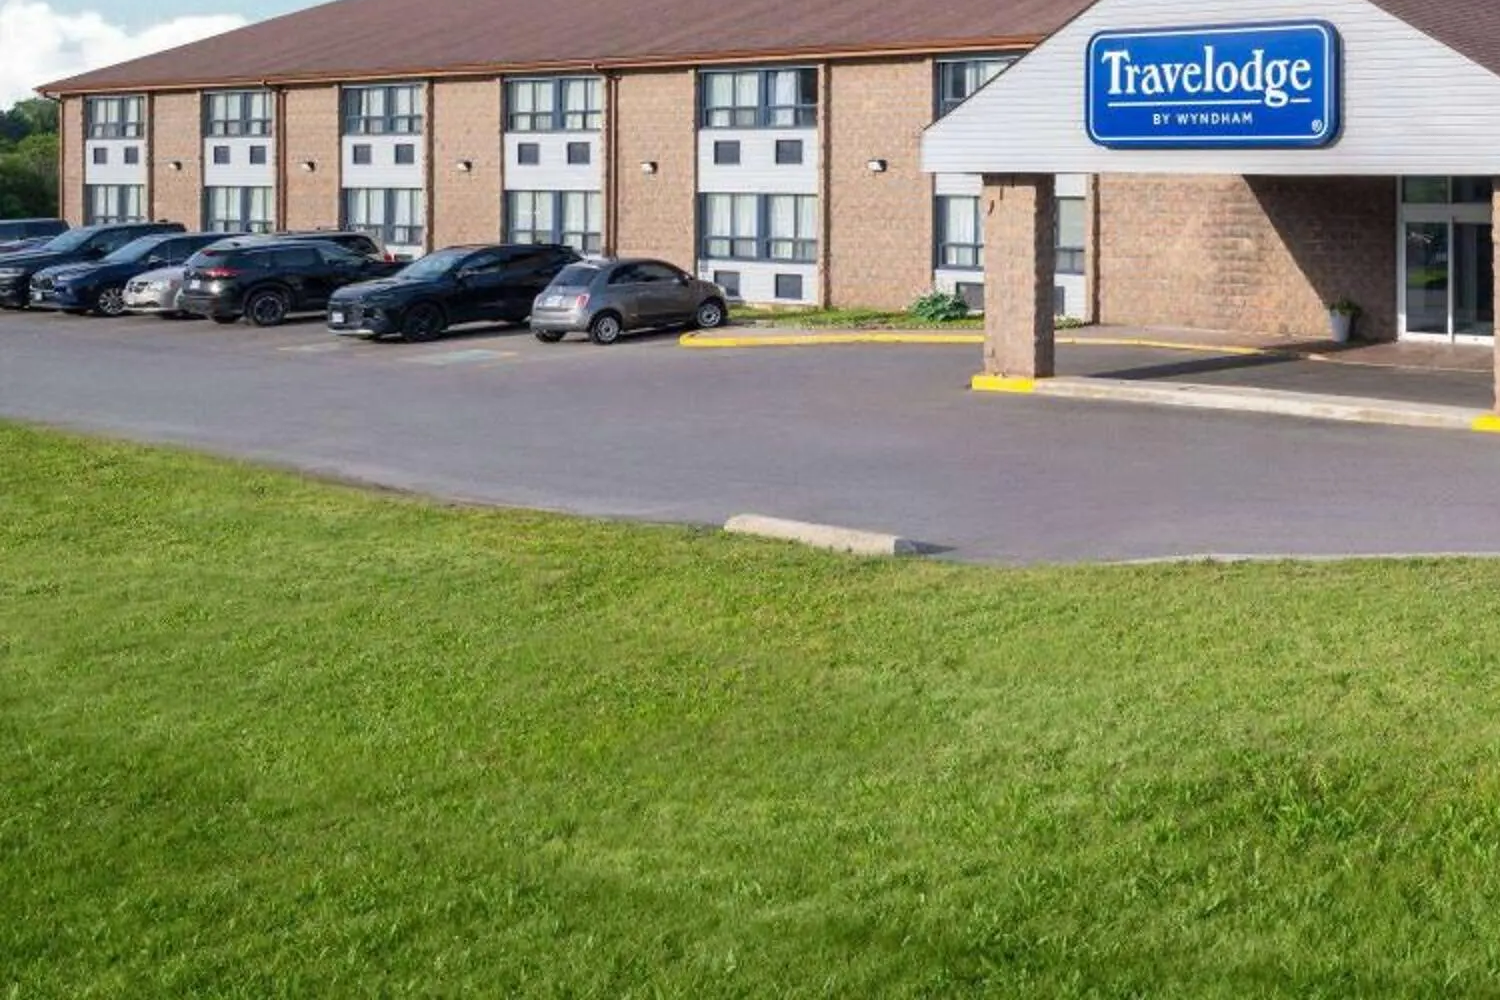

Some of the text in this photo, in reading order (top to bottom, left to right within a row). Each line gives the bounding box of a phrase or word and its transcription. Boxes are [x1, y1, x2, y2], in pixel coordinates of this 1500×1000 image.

[1101, 45, 1313, 108] Travelodge
[1152, 110, 1254, 126] BY WYNDHAM
